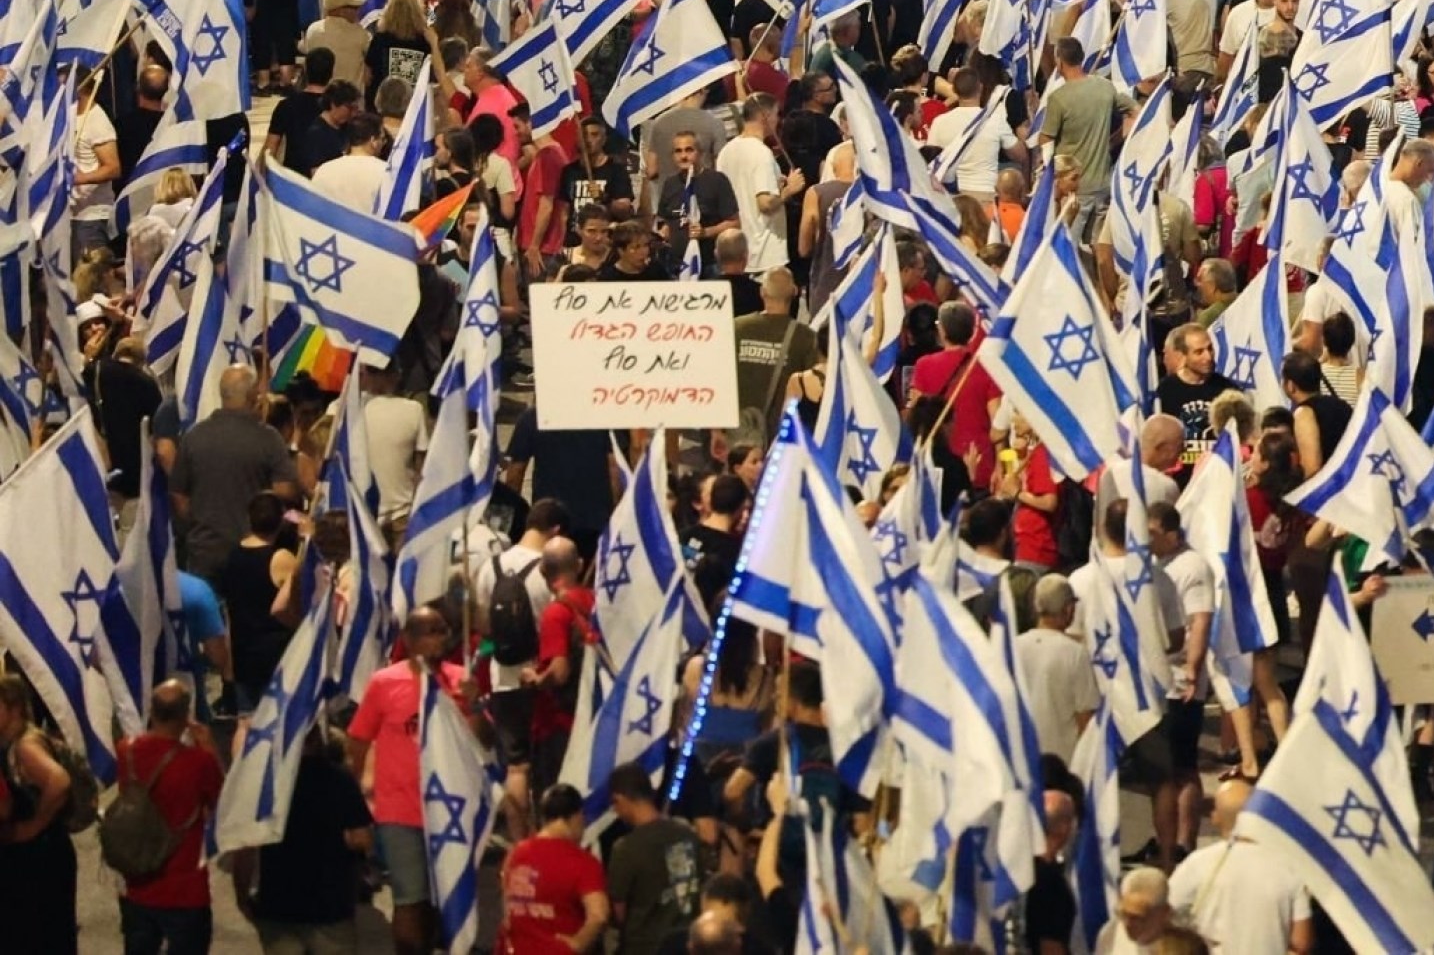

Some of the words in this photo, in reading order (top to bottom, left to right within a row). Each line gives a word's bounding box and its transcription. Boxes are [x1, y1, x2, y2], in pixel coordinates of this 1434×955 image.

[553, 285, 588, 311] סוף
[597, 289, 633, 315] את
[640, 292, 728, 315] מרגישות
[568, 318, 637, 342] הגדול
[646, 323, 714, 342] החופש
[603, 345, 638, 371] סוף
[644, 351, 690, 374] ואת
[592, 383, 715, 411] הדמוקרטיה
